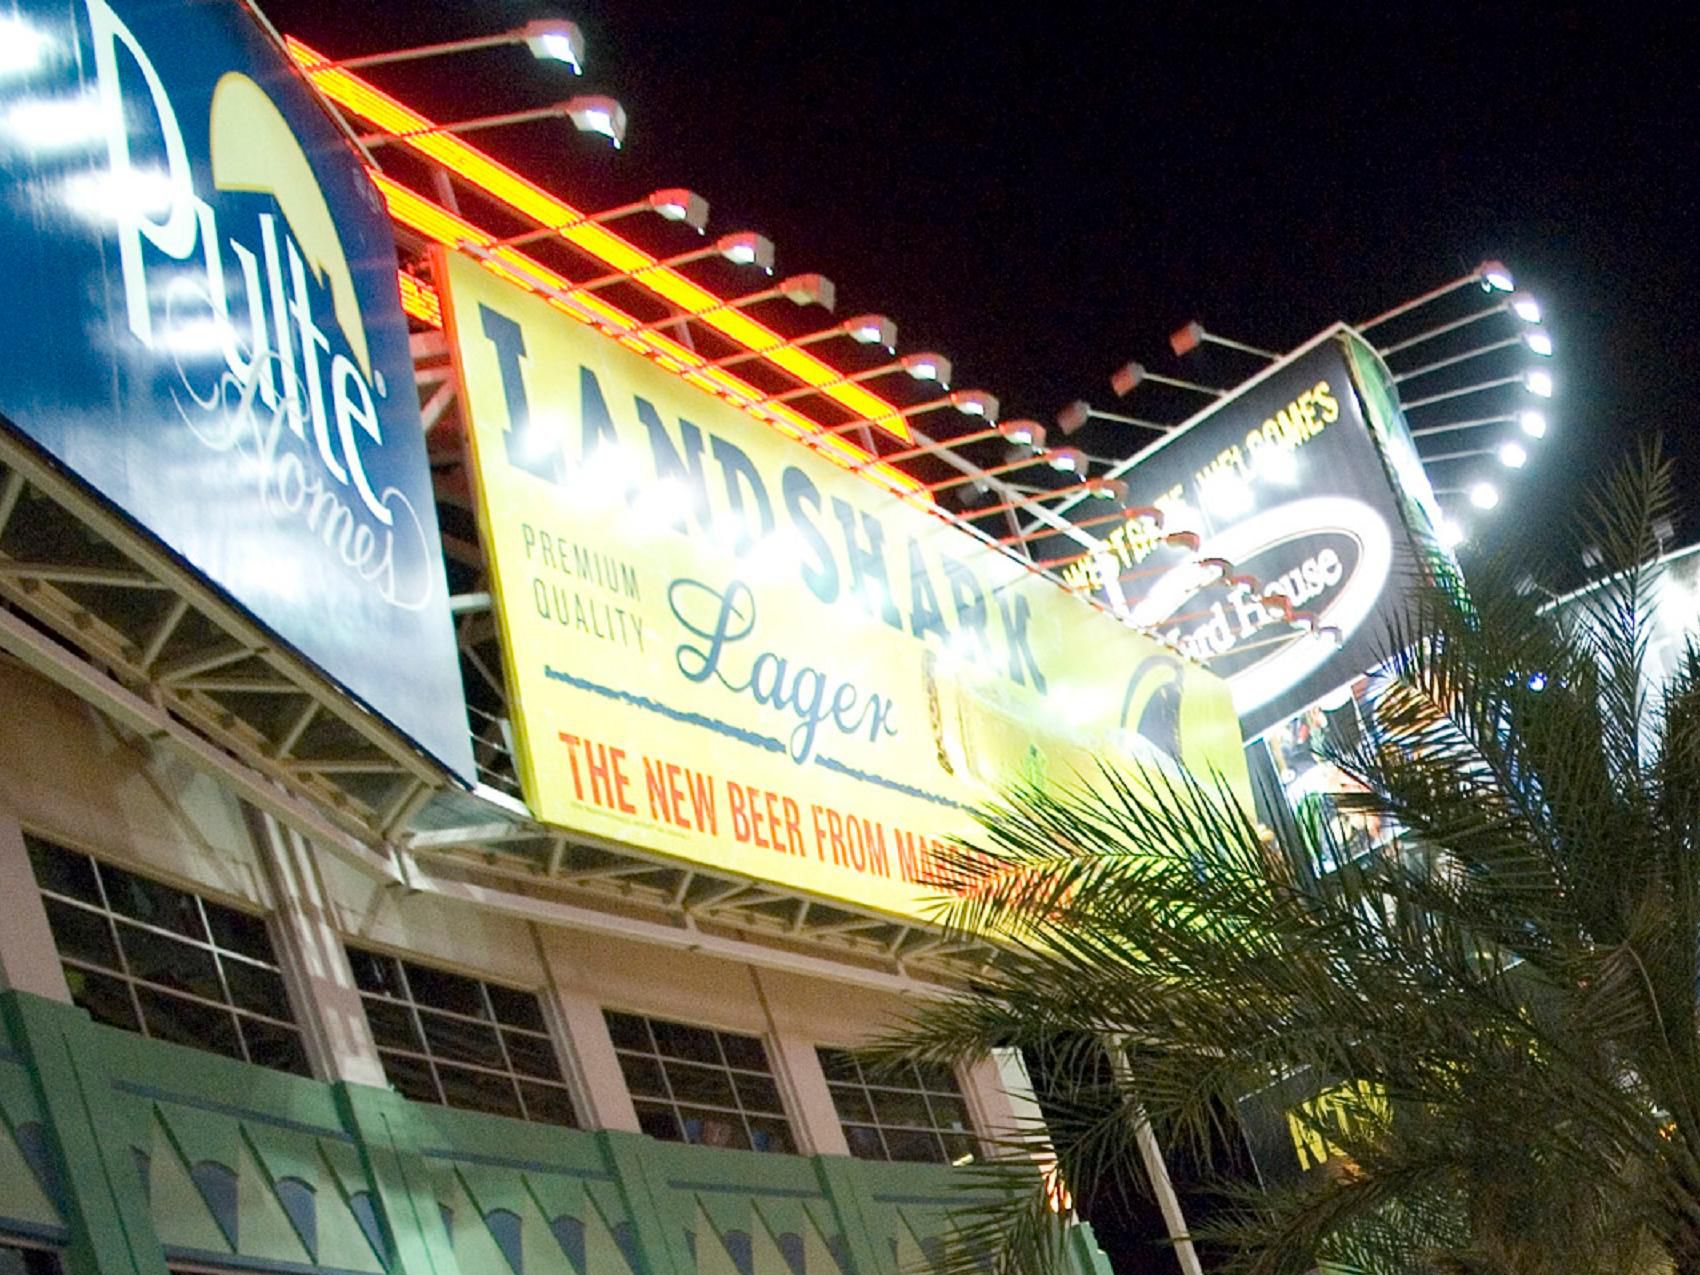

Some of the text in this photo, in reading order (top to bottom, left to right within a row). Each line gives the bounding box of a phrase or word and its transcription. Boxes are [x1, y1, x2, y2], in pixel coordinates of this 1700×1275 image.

[87, 0, 393, 525] Pulte
[521, 521, 643, 600] PREMIUM
[531, 577, 649, 655] QUALITY
[667, 575, 899, 767] Lager
[557, 731, 636, 815] THE
[641, 752, 720, 838] NEW
[726, 783, 808, 860] BEER
[814, 805, 891, 879] FROM
